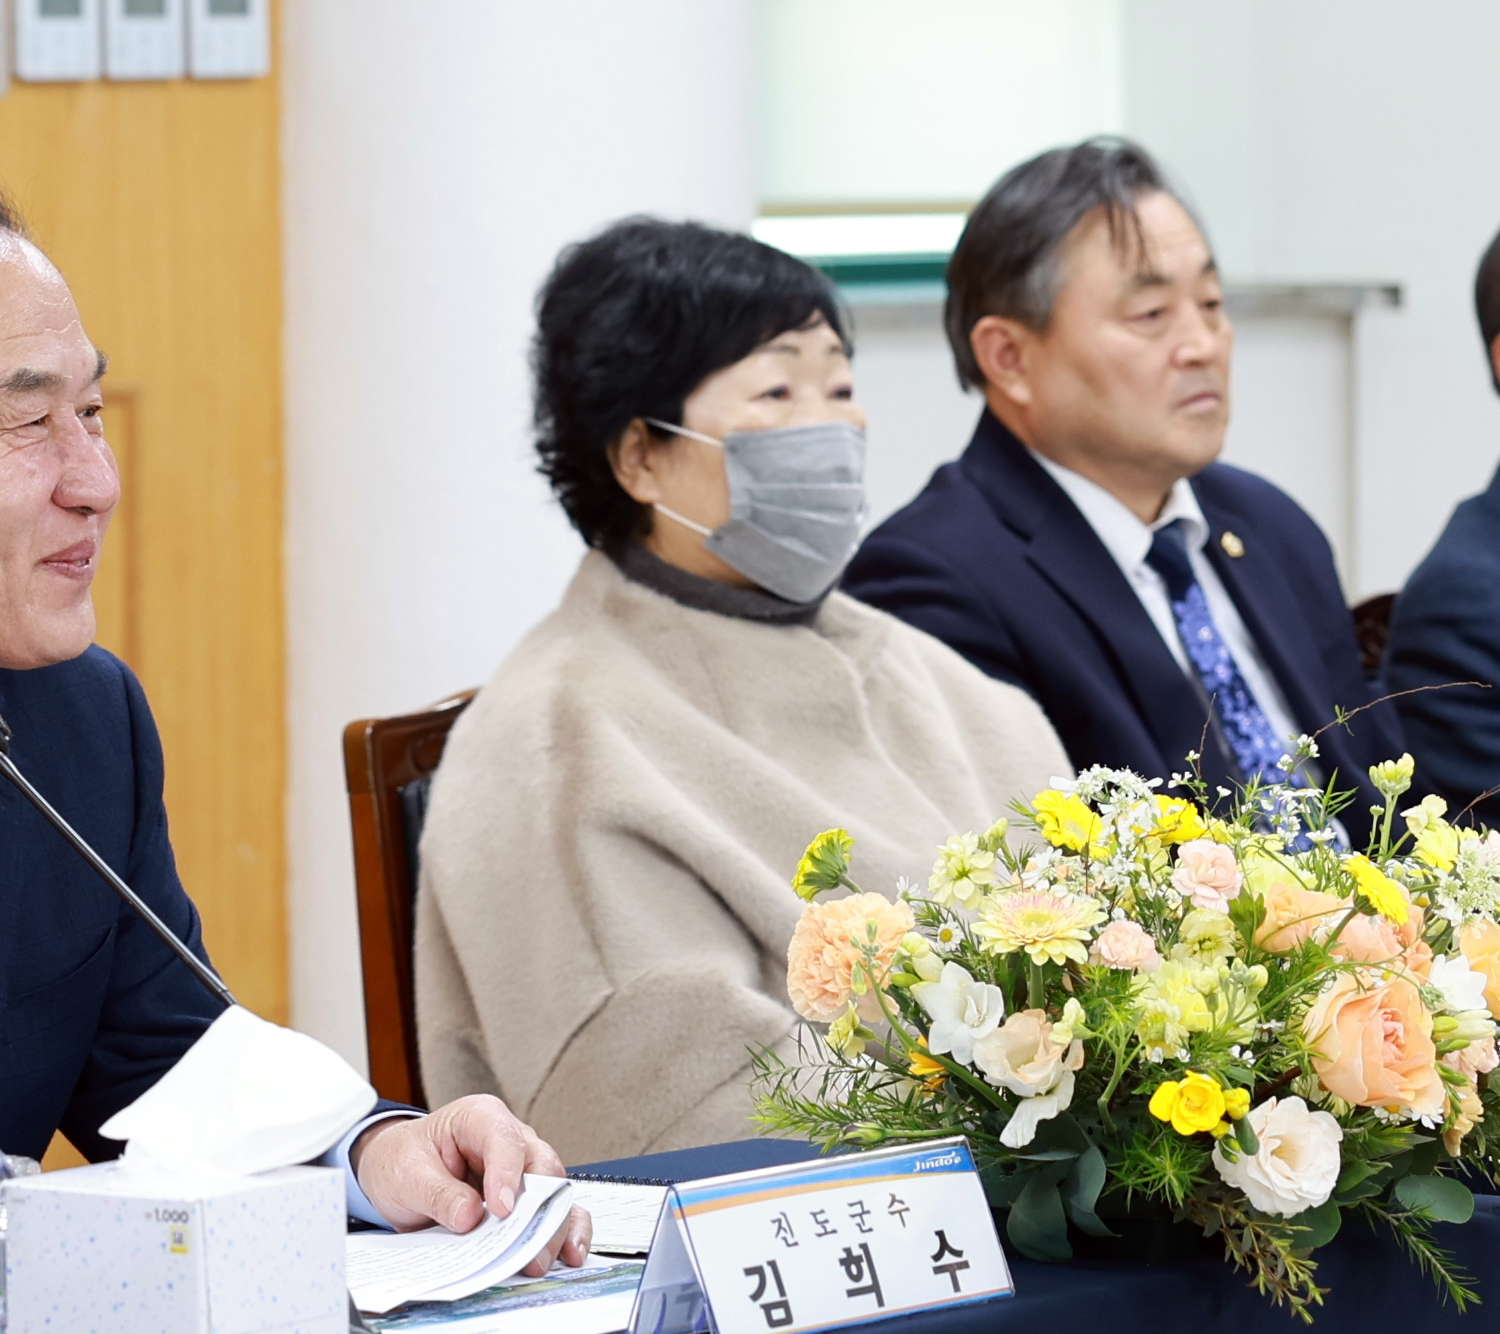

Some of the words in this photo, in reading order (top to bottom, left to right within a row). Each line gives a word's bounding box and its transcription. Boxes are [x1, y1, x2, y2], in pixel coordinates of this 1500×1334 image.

[913, 1153, 954, 1174] Jindo
[769, 1192, 911, 1249] 진도군수
[742, 1229, 971, 1329] 김희수
